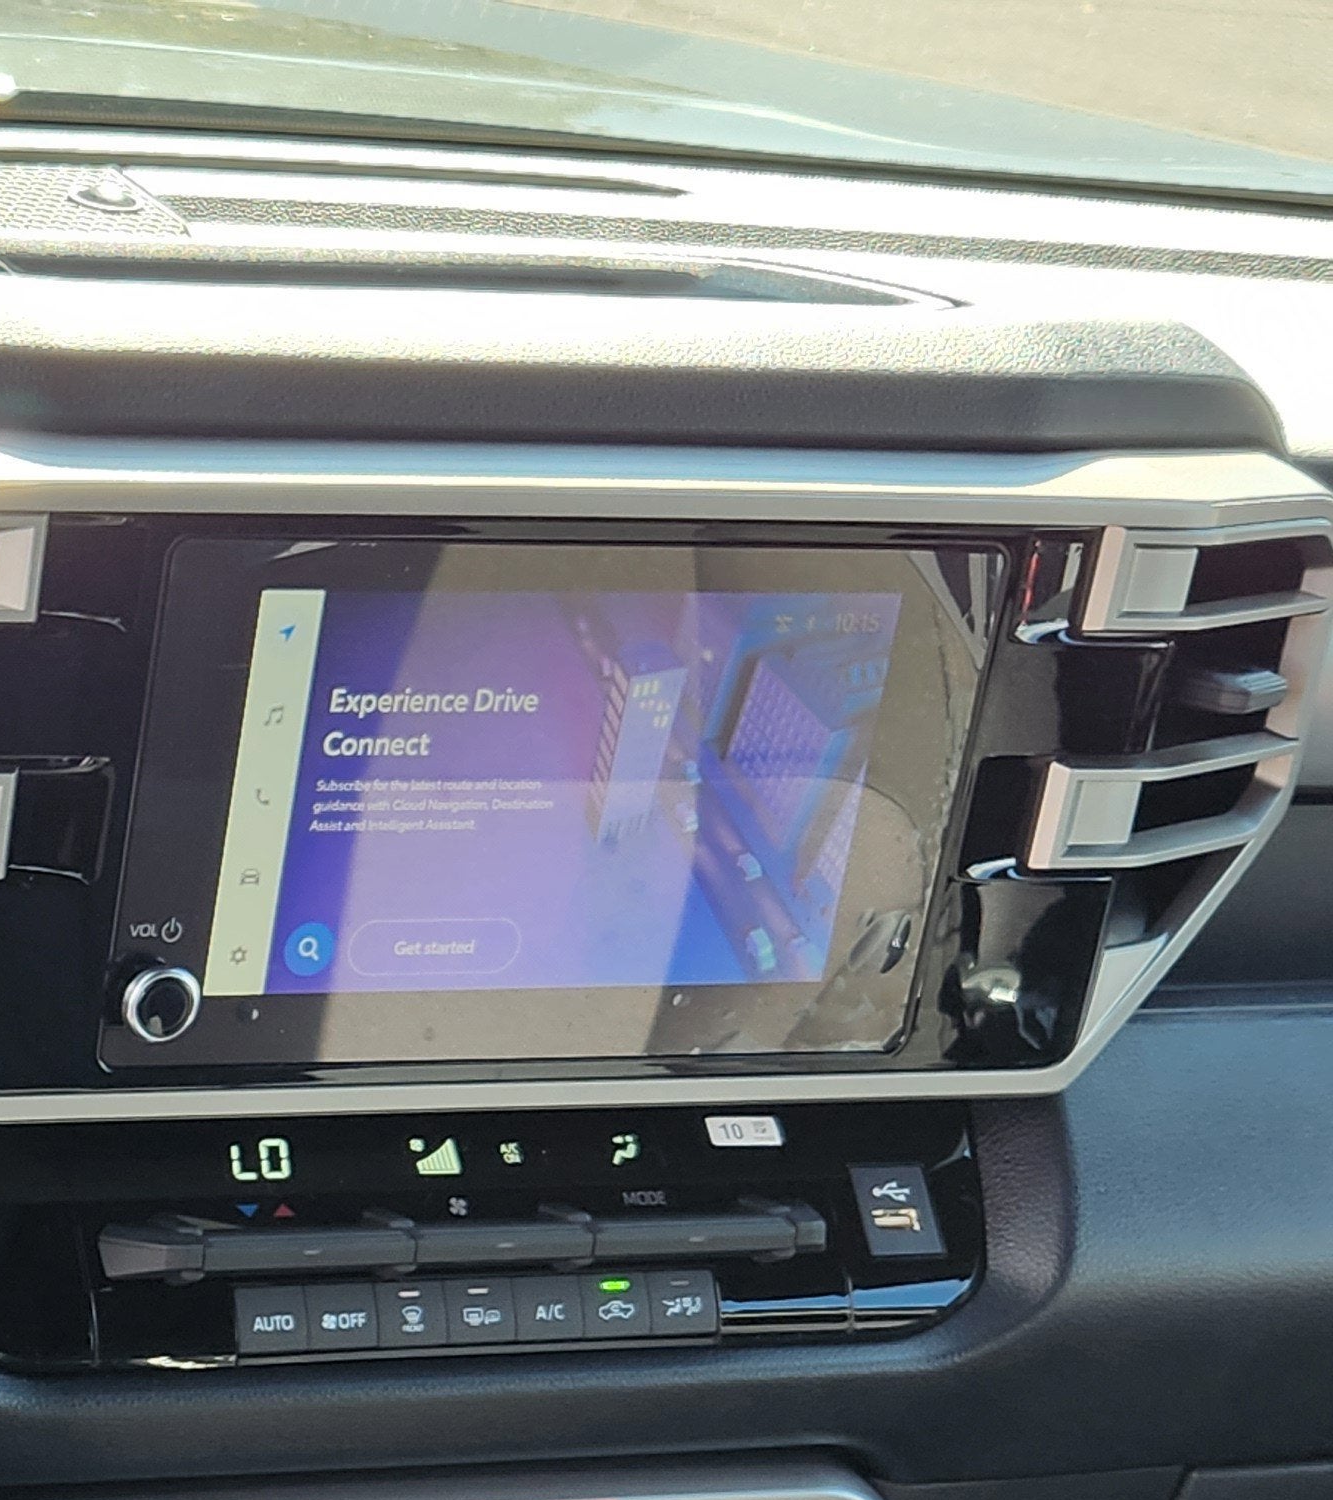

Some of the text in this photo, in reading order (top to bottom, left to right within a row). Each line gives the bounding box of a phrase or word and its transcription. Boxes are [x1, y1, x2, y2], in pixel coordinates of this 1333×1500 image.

[329, 688, 539, 718] Experience Drive
[323, 731, 431, 756] Connect
[130, 922, 157, 939] VOL
[394, 938, 475, 957] Get started
[719, 1123, 743, 1140] 10
[230, 1138, 292, 1181] LO
[622, 1190, 667, 1206] MODE
[337, 1312, 367, 1330] OFF
[535, 1304, 566, 1321] A/C
[253, 1314, 295, 1332] AUTO
